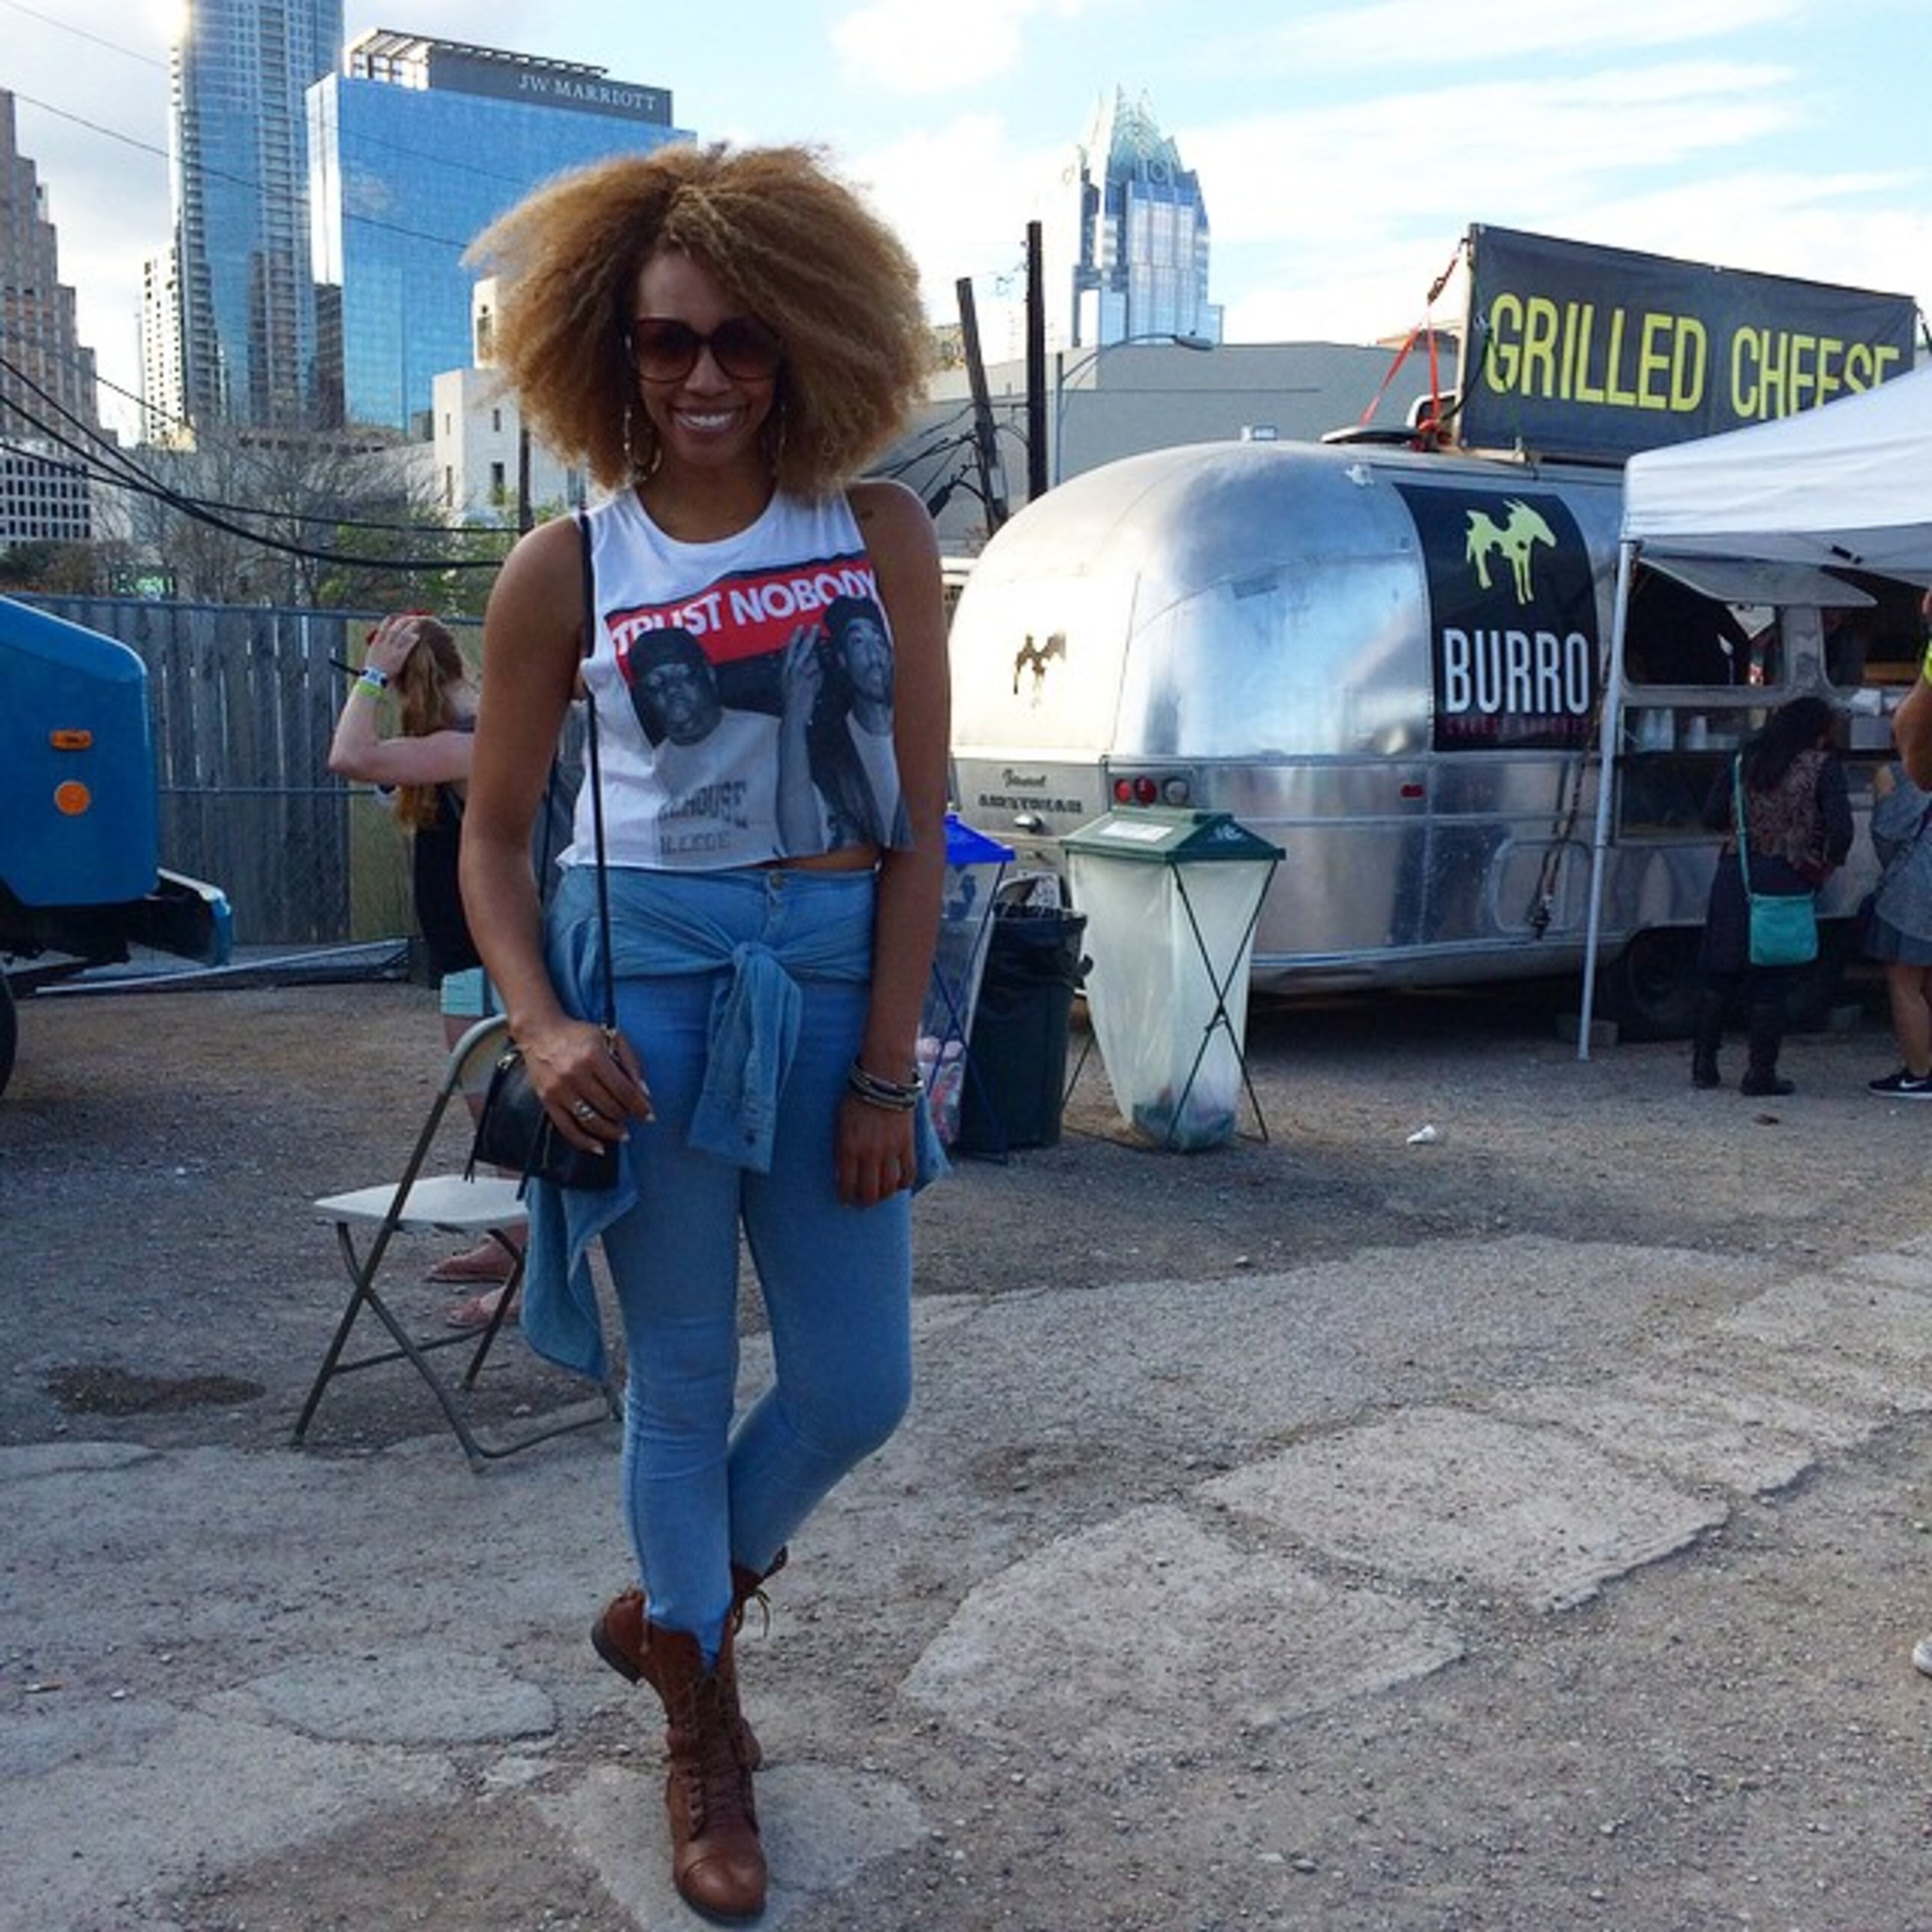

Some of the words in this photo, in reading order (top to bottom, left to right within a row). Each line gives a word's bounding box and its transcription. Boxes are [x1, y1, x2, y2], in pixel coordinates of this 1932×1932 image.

[518, 73, 550, 93] JW
[554, 79, 657, 110] MARRIOTT
[1486, 294, 1706, 413] GRILLED
[730, 568, 878, 627] NOBODY
[1442, 628, 1590, 714] BURRO
